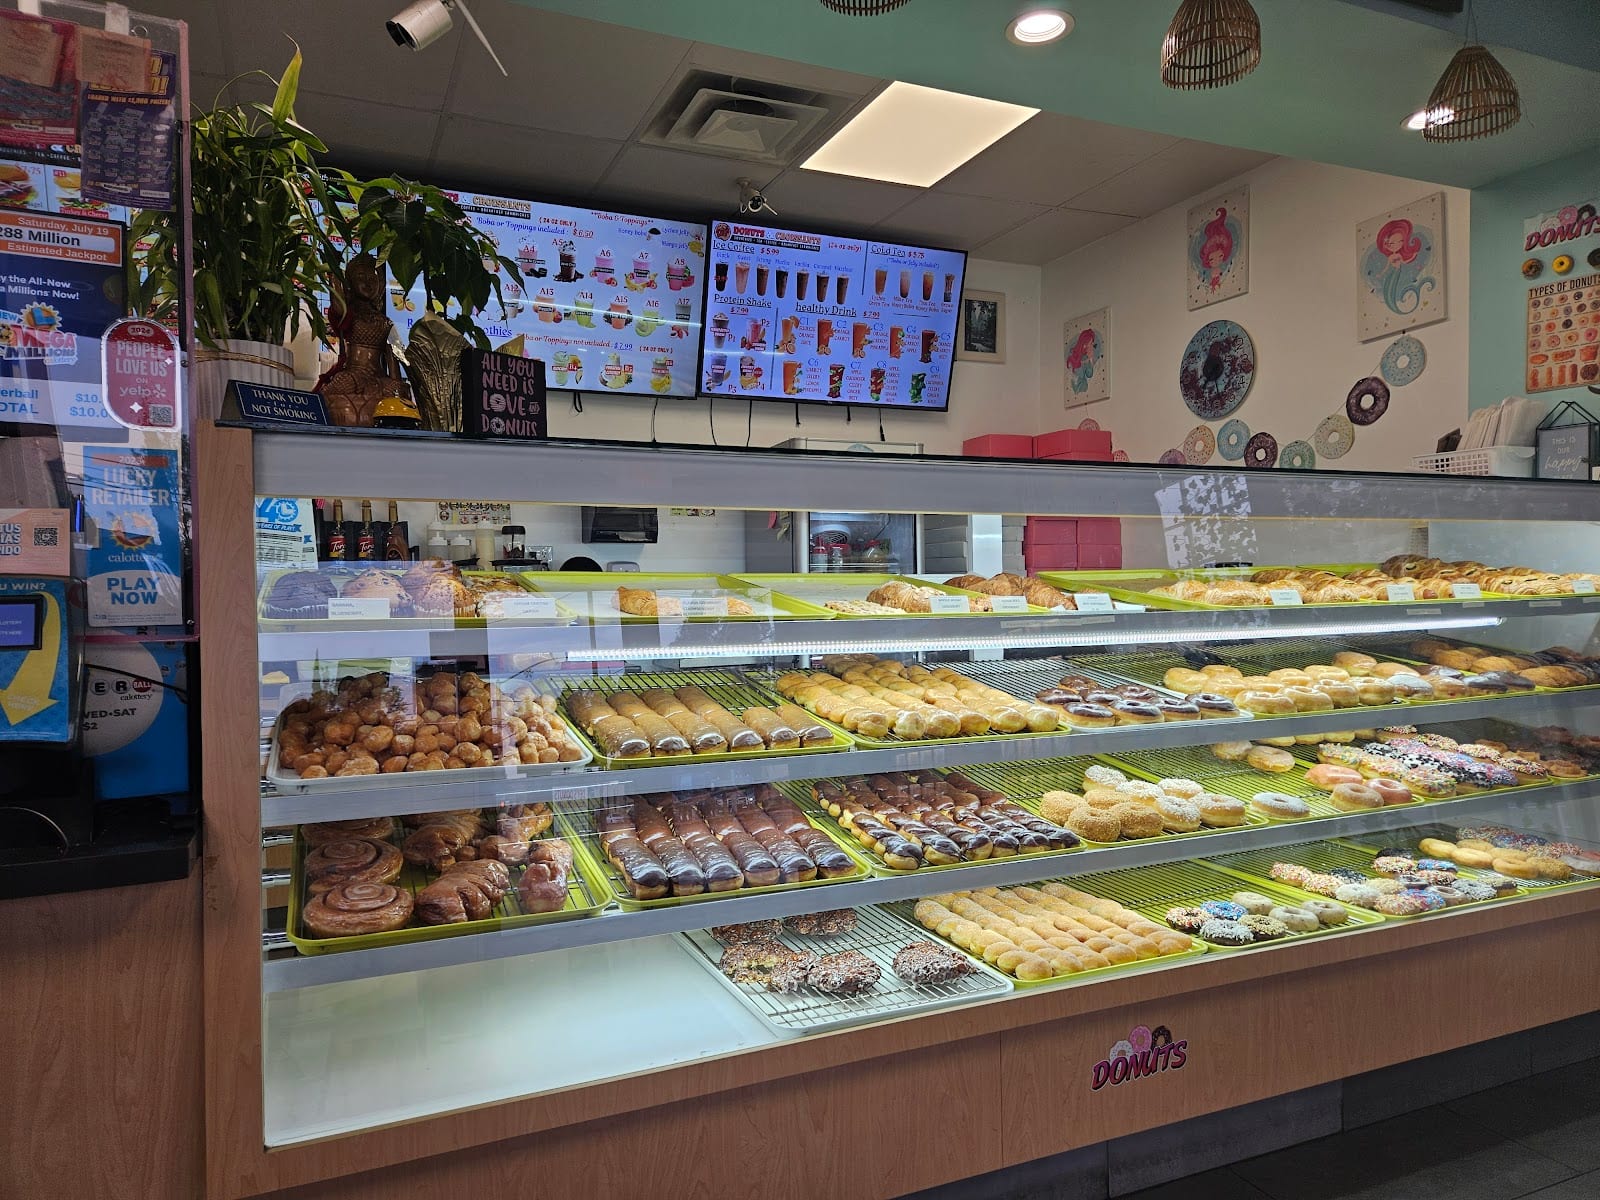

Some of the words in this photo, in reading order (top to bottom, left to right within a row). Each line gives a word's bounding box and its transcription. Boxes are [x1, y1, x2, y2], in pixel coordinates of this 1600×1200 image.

[473, 196, 531, 211] CROISSANTS
[18, 217, 68, 231] Saturday,
[72, 224, 93, 235] July
[477, 217, 495, 226] Boba
[506, 221, 536, 232] Toppings
[28, 230, 80, 246] Million
[733, 226, 765, 237] DONUTS
[775, 232, 821, 245] CROISSANTS
[8, 242, 62, 256] Estimated
[66, 249, 108, 261] Jackpot
[600, 249, 611, 257] A6
[713, 241, 726, 250] Ice
[727, 242, 755, 253] Coffee
[871, 245, 890, 255] Cold
[892, 248, 905, 257] Tea
[8, 275, 26, 284] the
[28, 276, 71, 289] All-New
[504, 284, 519, 292] A12
[1529, 284, 1554, 297] TYPES
[1557, 281, 1567, 292] OF
[8, 285, 49, 297] Millions
[52, 290, 80, 300] Now!
[540, 288, 554, 296] A13
[579, 292, 593, 300] A14
[714, 294, 745, 304] Protein
[747, 297, 772, 308] Shake
[796, 302, 829, 315] healthy
[832, 307, 857, 317] Drink
[800, 317, 809, 326] C1
[837, 321, 847, 329] C2
[874, 323, 884, 331] C3
[11, 324, 77, 349] MEGA
[117, 340, 166, 358] PEOPLE
[116, 358, 147, 375] LOVE
[150, 361, 167, 377] US
[481, 353, 502, 372] ALL
[482, 371, 517, 392] NEED
[119, 385, 151, 399] yelp
[252, 389, 286, 402] THANK
[288, 395, 308, 405] YOU
[483, 390, 526, 416] LOVE
[252, 404, 271, 414] NOT
[274, 407, 317, 420] SMOKING
[481, 413, 537, 436] DONUTS
[1545, 455, 1581, 471] happy
[104, 468, 156, 487] LUCKY
[92, 488, 170, 506] RETAILER
[12, 582, 46, 591] WIN?
[107, 577, 160, 591] PLAY
[110, 591, 158, 605] NOW
[1092, 1040, 1187, 1091] DONUTS
